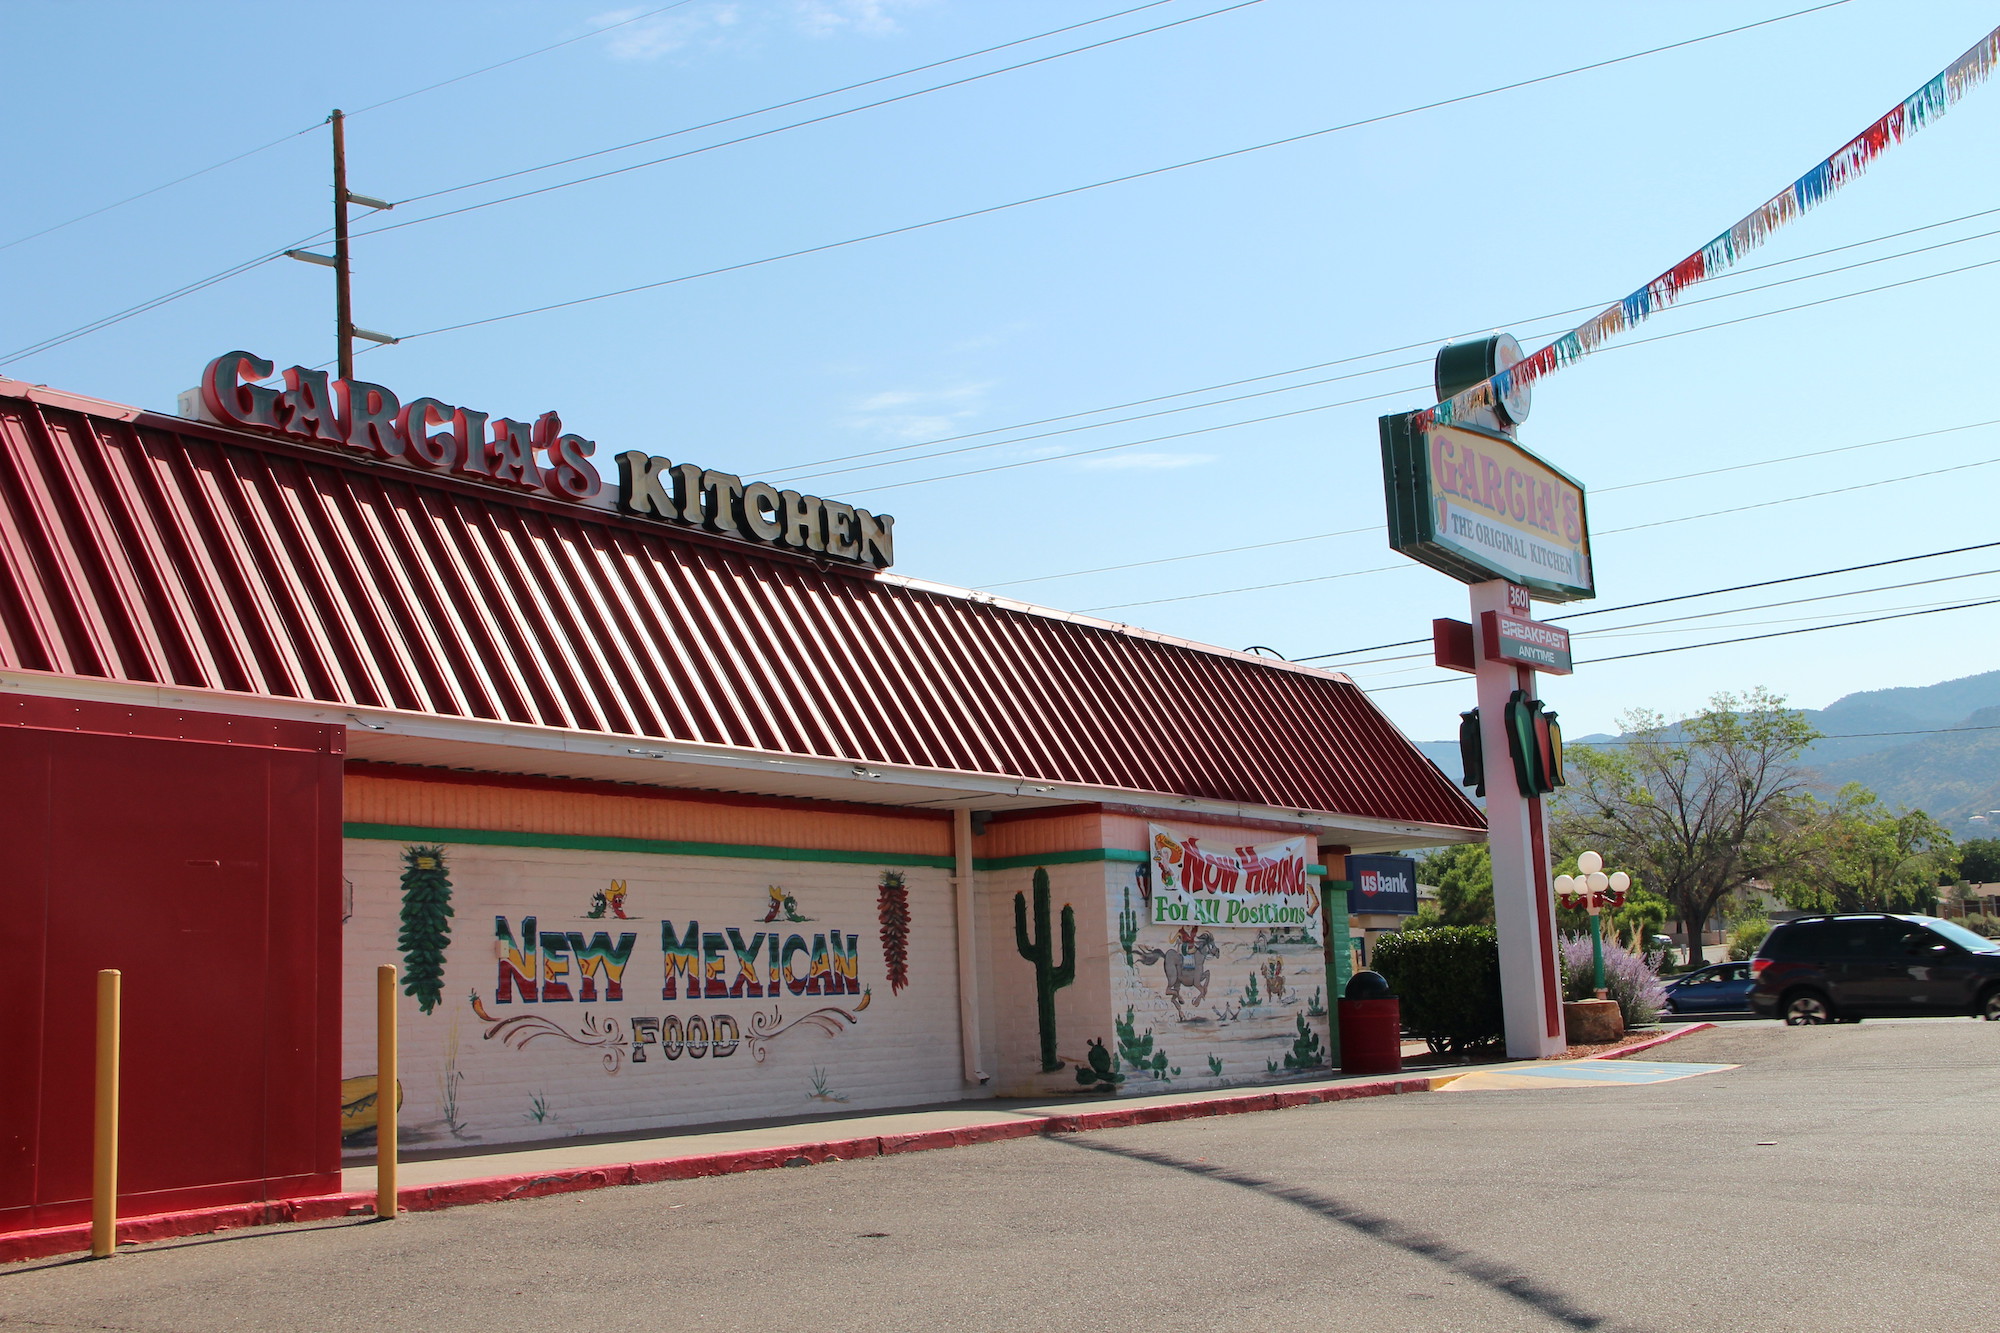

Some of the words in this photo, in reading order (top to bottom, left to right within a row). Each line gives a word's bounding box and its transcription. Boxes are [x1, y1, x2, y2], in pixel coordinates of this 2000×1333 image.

[202, 350, 602, 501] GARCIA'S
[614, 450, 895, 568] KITCHEN
[1432, 434, 1582, 545] GARCIA'S
[1451, 513, 1474, 539] THE
[1476, 522, 1527, 560] ORIGINAL
[1529, 542, 1572, 575] KITCHEN
[1509, 586, 1528, 608] 3601
[1501, 619, 1566, 649] BREAKFAST
[1519, 645, 1555, 663] ANYTIME
[1180, 837, 1239, 894] NOW
[1235, 846, 1306, 896] HIRING
[1154, 896, 1190, 922] For
[1194, 898, 1221, 924] All
[1226, 899, 1306, 924] Positions
[495, 915, 637, 1004] NEW
[661, 920, 861, 1000] MEXICAN
[632, 1014, 740, 1063] FOOD
